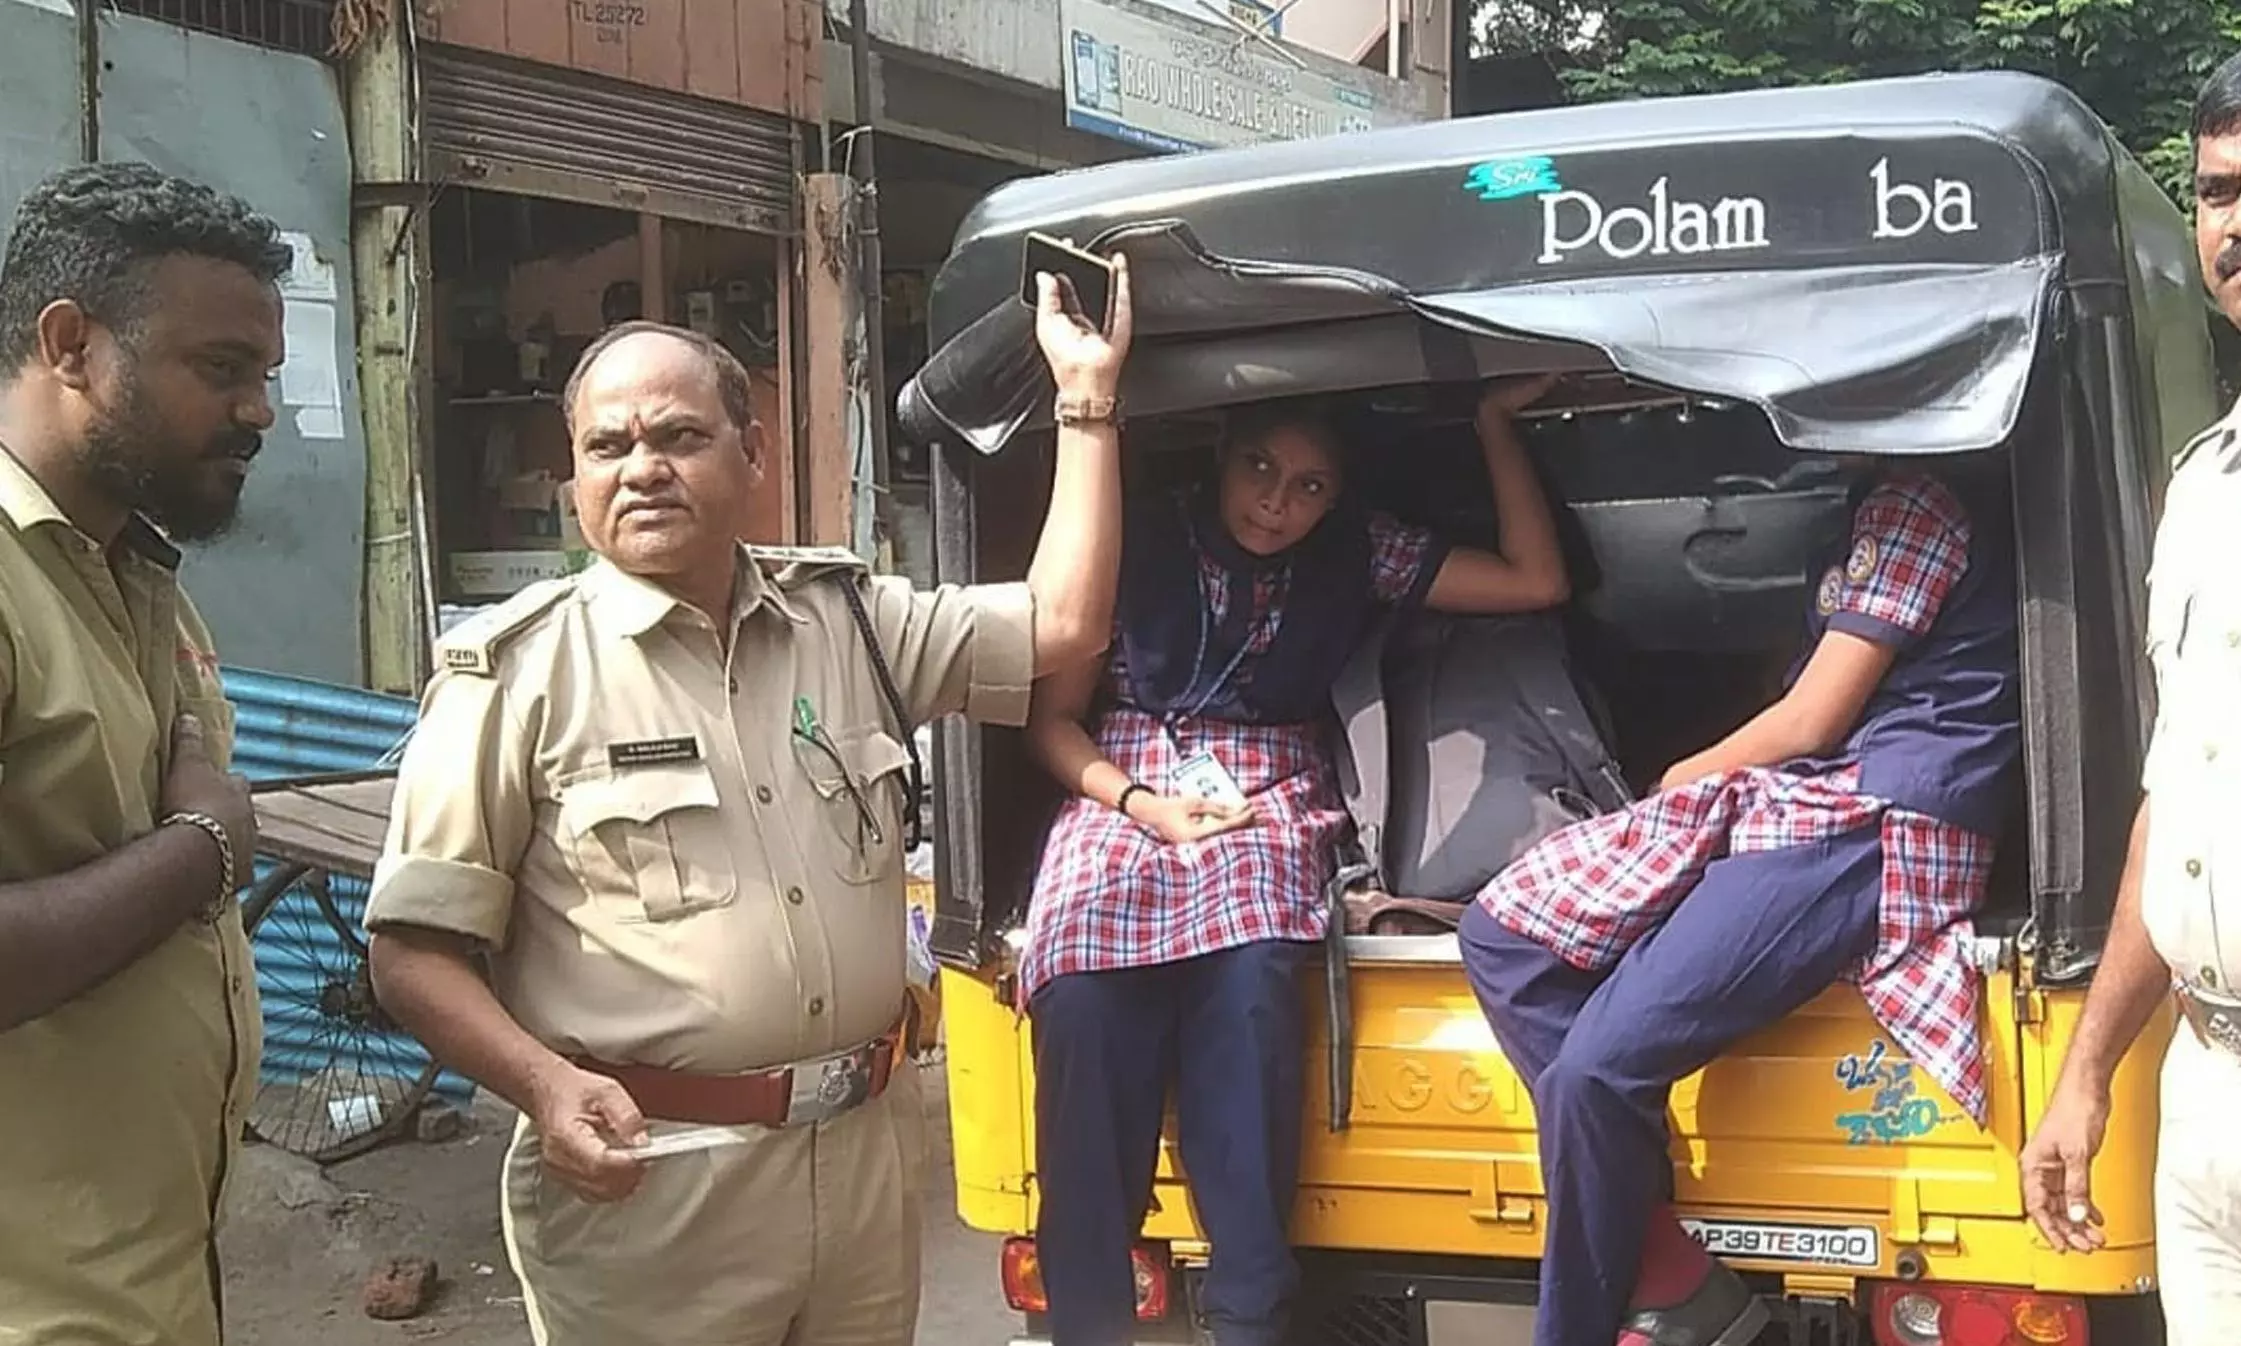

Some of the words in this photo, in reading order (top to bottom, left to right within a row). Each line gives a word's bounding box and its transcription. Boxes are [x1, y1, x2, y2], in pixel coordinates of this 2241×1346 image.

[1122, 50, 1161, 105] RAO
[1164, 62, 1223, 121] WHOLE
[1537, 176, 1770, 264] Polam
[1870, 156, 1978, 239] ba
[1351, 1057, 1520, 1114] AGGI
